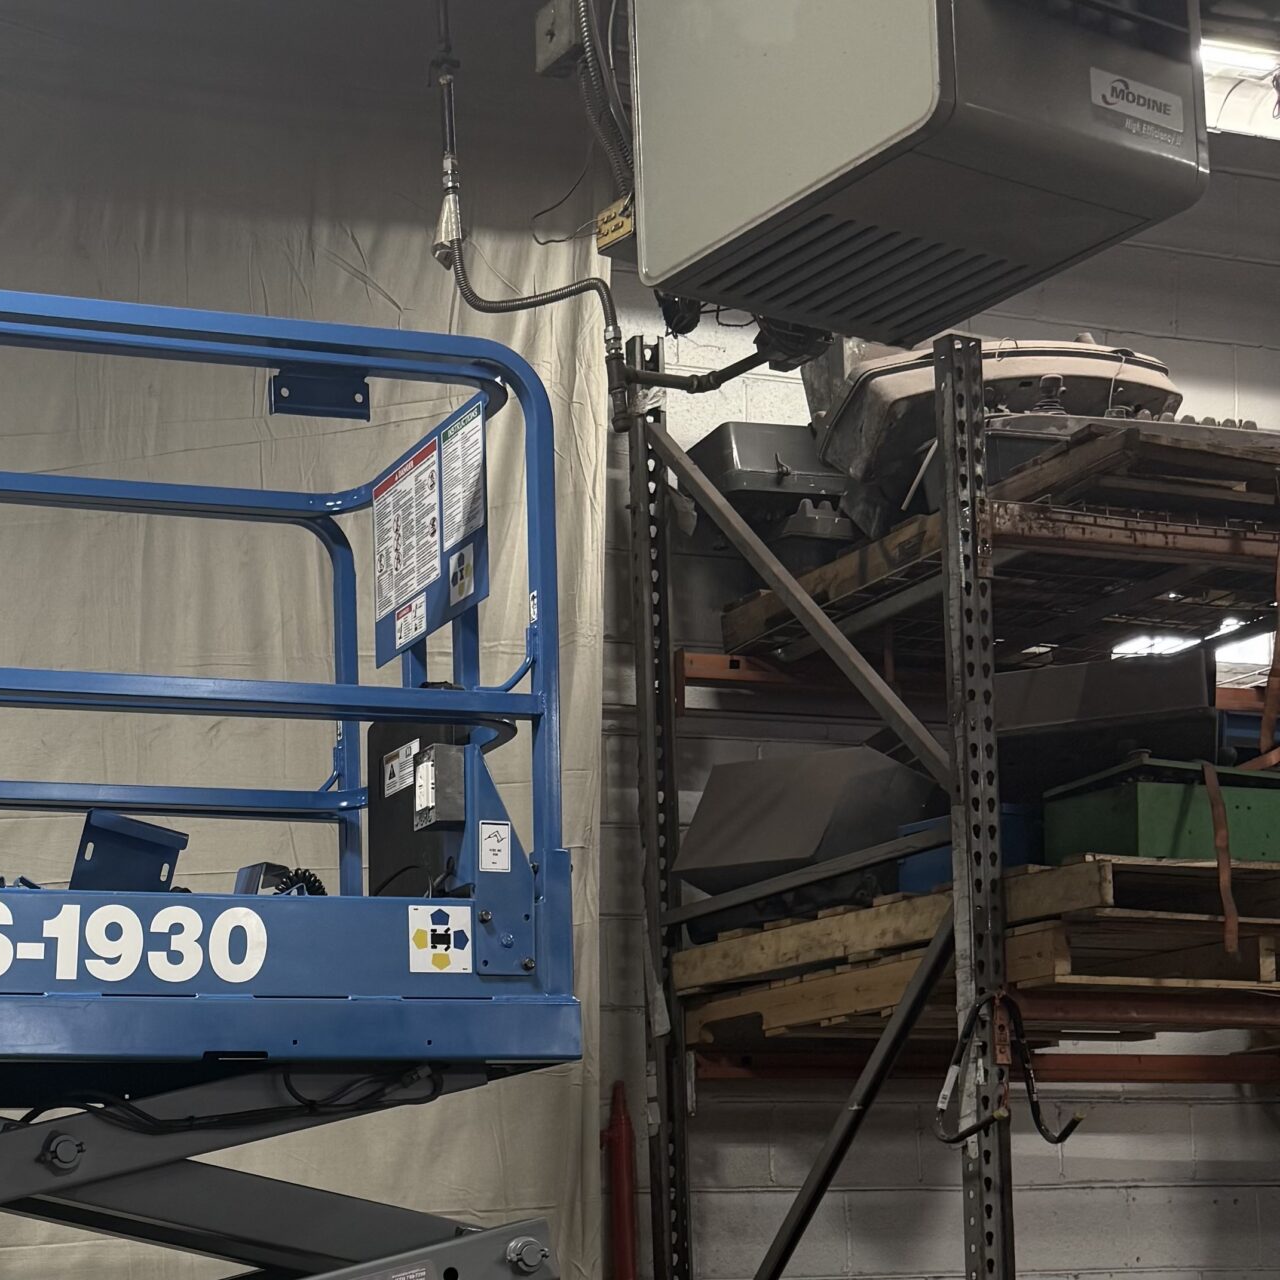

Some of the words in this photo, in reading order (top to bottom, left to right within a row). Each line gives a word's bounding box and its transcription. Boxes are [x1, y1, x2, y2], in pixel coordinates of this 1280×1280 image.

[1111, 86, 1172, 115] MODINE
[1125, 118, 1140, 133] High
[1142, 123, 1174, 144] Efficiency
